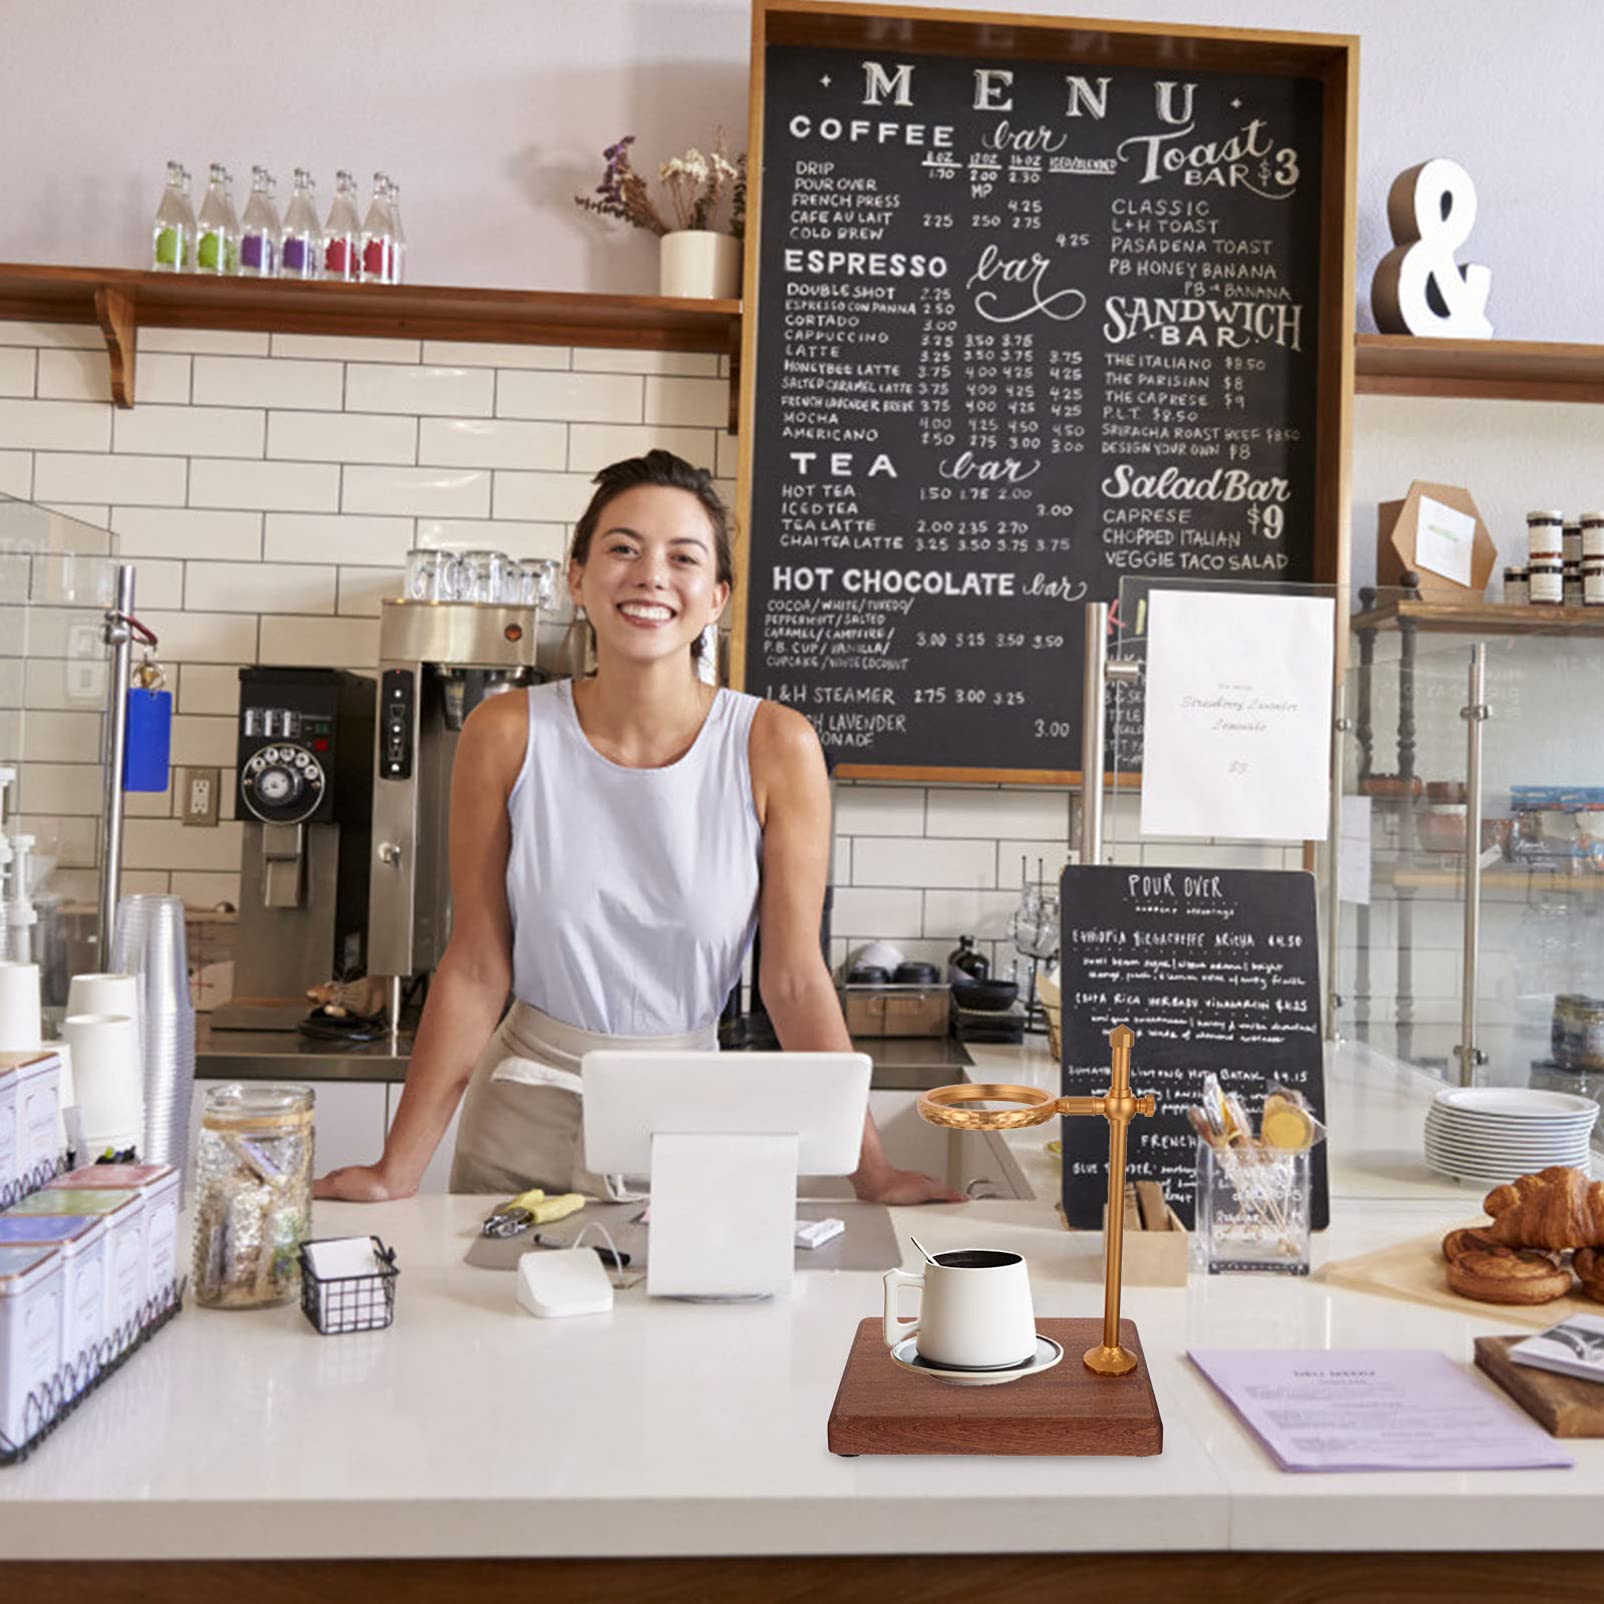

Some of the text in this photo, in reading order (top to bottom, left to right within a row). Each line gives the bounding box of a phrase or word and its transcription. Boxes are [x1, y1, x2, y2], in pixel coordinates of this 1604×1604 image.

[789, 115, 1067, 152] COFFEE bar
[1117, 119, 1273, 184] Toast
[795, 161, 834, 175] DRIP
[794, 178, 834, 191] POUR
[837, 179, 877, 191] OVER
[792, 193, 851, 207] FRENCH
[856, 195, 900, 207] PRESS
[1111, 198, 1210, 216] CLASSIC
[790, 210, 892, 224] CAFE AU LAIT
[790, 227, 831, 240] COLD
[837, 227, 884, 240] BREW
[1156, 219, 1220, 234] TOAST
[1111, 236, 1273, 254] PASADENA TOAST
[1382, 158, 1494, 340] &
[785, 249, 947, 277] ESPRESSO
[1109, 258, 1277, 279] PB HONEY BANANA
[787, 282, 850, 297] DOUBLE
[853, 285, 896, 299] SHOT
[1184, 281, 1293, 301] PB BANANA
[785, 301, 916, 315] ESPRESSO CON PANNA
[785, 314, 860, 326] CORTADO
[1103, 296, 1302, 352] SANDWICH
[784, 329, 889, 343] CAPPUCCINO
[1161, 325, 1250, 348] BAR
[785, 344, 840, 358] LATTE
[783, 359, 853, 375] HONEYBEE
[857, 364, 900, 376] LATTE
[1105, 353, 1135, 366] THE
[1138, 355, 1212, 370] ITALIANO
[781, 376, 824, 389] SALTED
[825, 379, 877, 393] CARAMEL
[879, 382, 913, 395] LATTE
[1105, 371, 1243, 390] THE PARISIAN $8
[781, 396, 822, 408] FRENCH
[824, 397, 880, 412] LAVENDER
[1105, 390, 1245, 409] THE CAPRESE $9
[784, 412, 839, 424] MOCHA
[782, 426, 879, 441] AMERICANO
[1101, 423, 1260, 441] SRIRACHA ROAST BEEF
[1101, 441, 1150, 454] DESIGN
[1154, 443, 1187, 456] YOUR
[1190, 444, 1219, 456] OWN
[790, 451, 1041, 482] TEA bar
[782, 484, 816, 498] HOT
[822, 484, 856, 498] TEA
[1101, 464, 1291, 501] Salad Bar
[782, 502, 823, 515] ICED
[826, 502, 858, 515] TEA
[781, 518, 816, 531] TEA
[821, 519, 876, 532] LATTE
[1103, 503, 1284, 539] CAPRESE $9
[780, 534, 818, 547] CHAI
[821, 535, 850, 548] TEA
[854, 536, 903, 549] LATTE
[1103, 528, 1240, 548] CHOPPED ITALIAN
[1106, 550, 1289, 570] VEGGIE TACO SALAD
[773, 566, 1087, 601] HOT CHOCOLATE bar
[814, 687, 895, 705] STEAMER
[829, 713, 906, 732] LAVENDER
[1128, 873, 1223, 897] POUR OVER
[1114, 992, 1140, 1005] RICA
[1220, 1069, 1265, 1081] BATAK
[1141, 1134, 1199, 1148] FRENCH
[1073, 1163, 1099, 1175] BLUE
